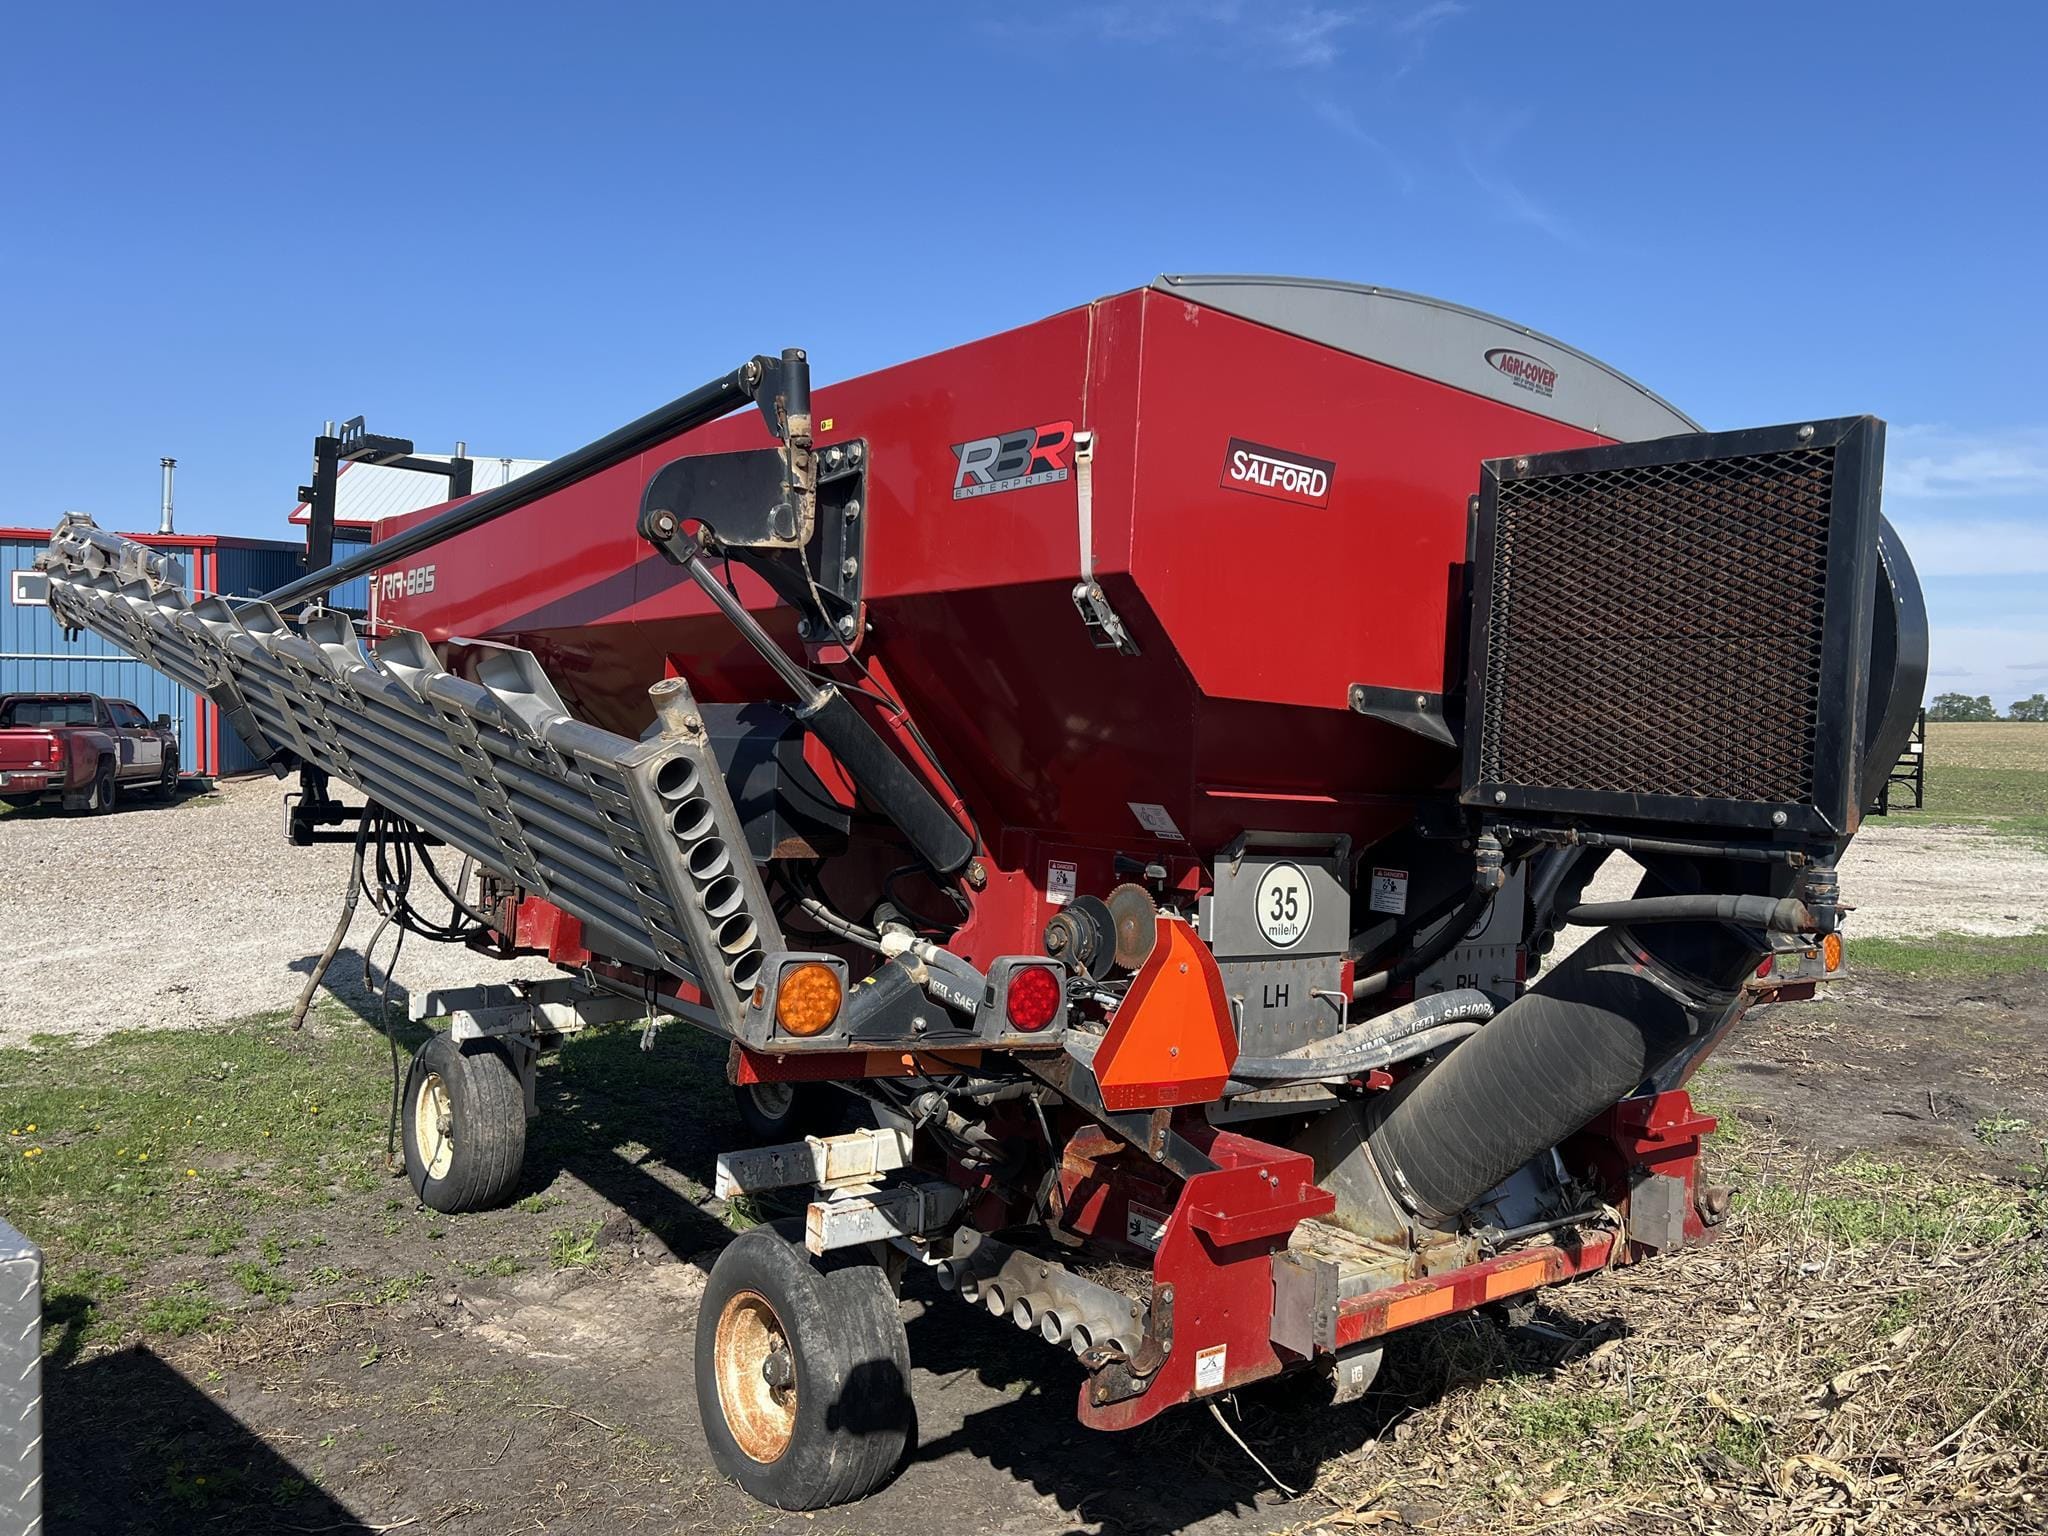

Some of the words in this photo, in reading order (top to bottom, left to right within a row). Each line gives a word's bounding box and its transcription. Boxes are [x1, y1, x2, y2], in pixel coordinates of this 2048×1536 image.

[1500, 354, 1555, 388] AGRI-COVER
[954, 421, 1074, 488] RBR
[955, 471, 1067, 498] ENTERPRISE
[1230, 450, 1327, 497] SALFORD
[1270, 887, 1298, 921] 35
[1268, 923, 1299, 936] mile/h
[1263, 984, 1289, 1008] LH
[1456, 973, 1479, 989] RH
